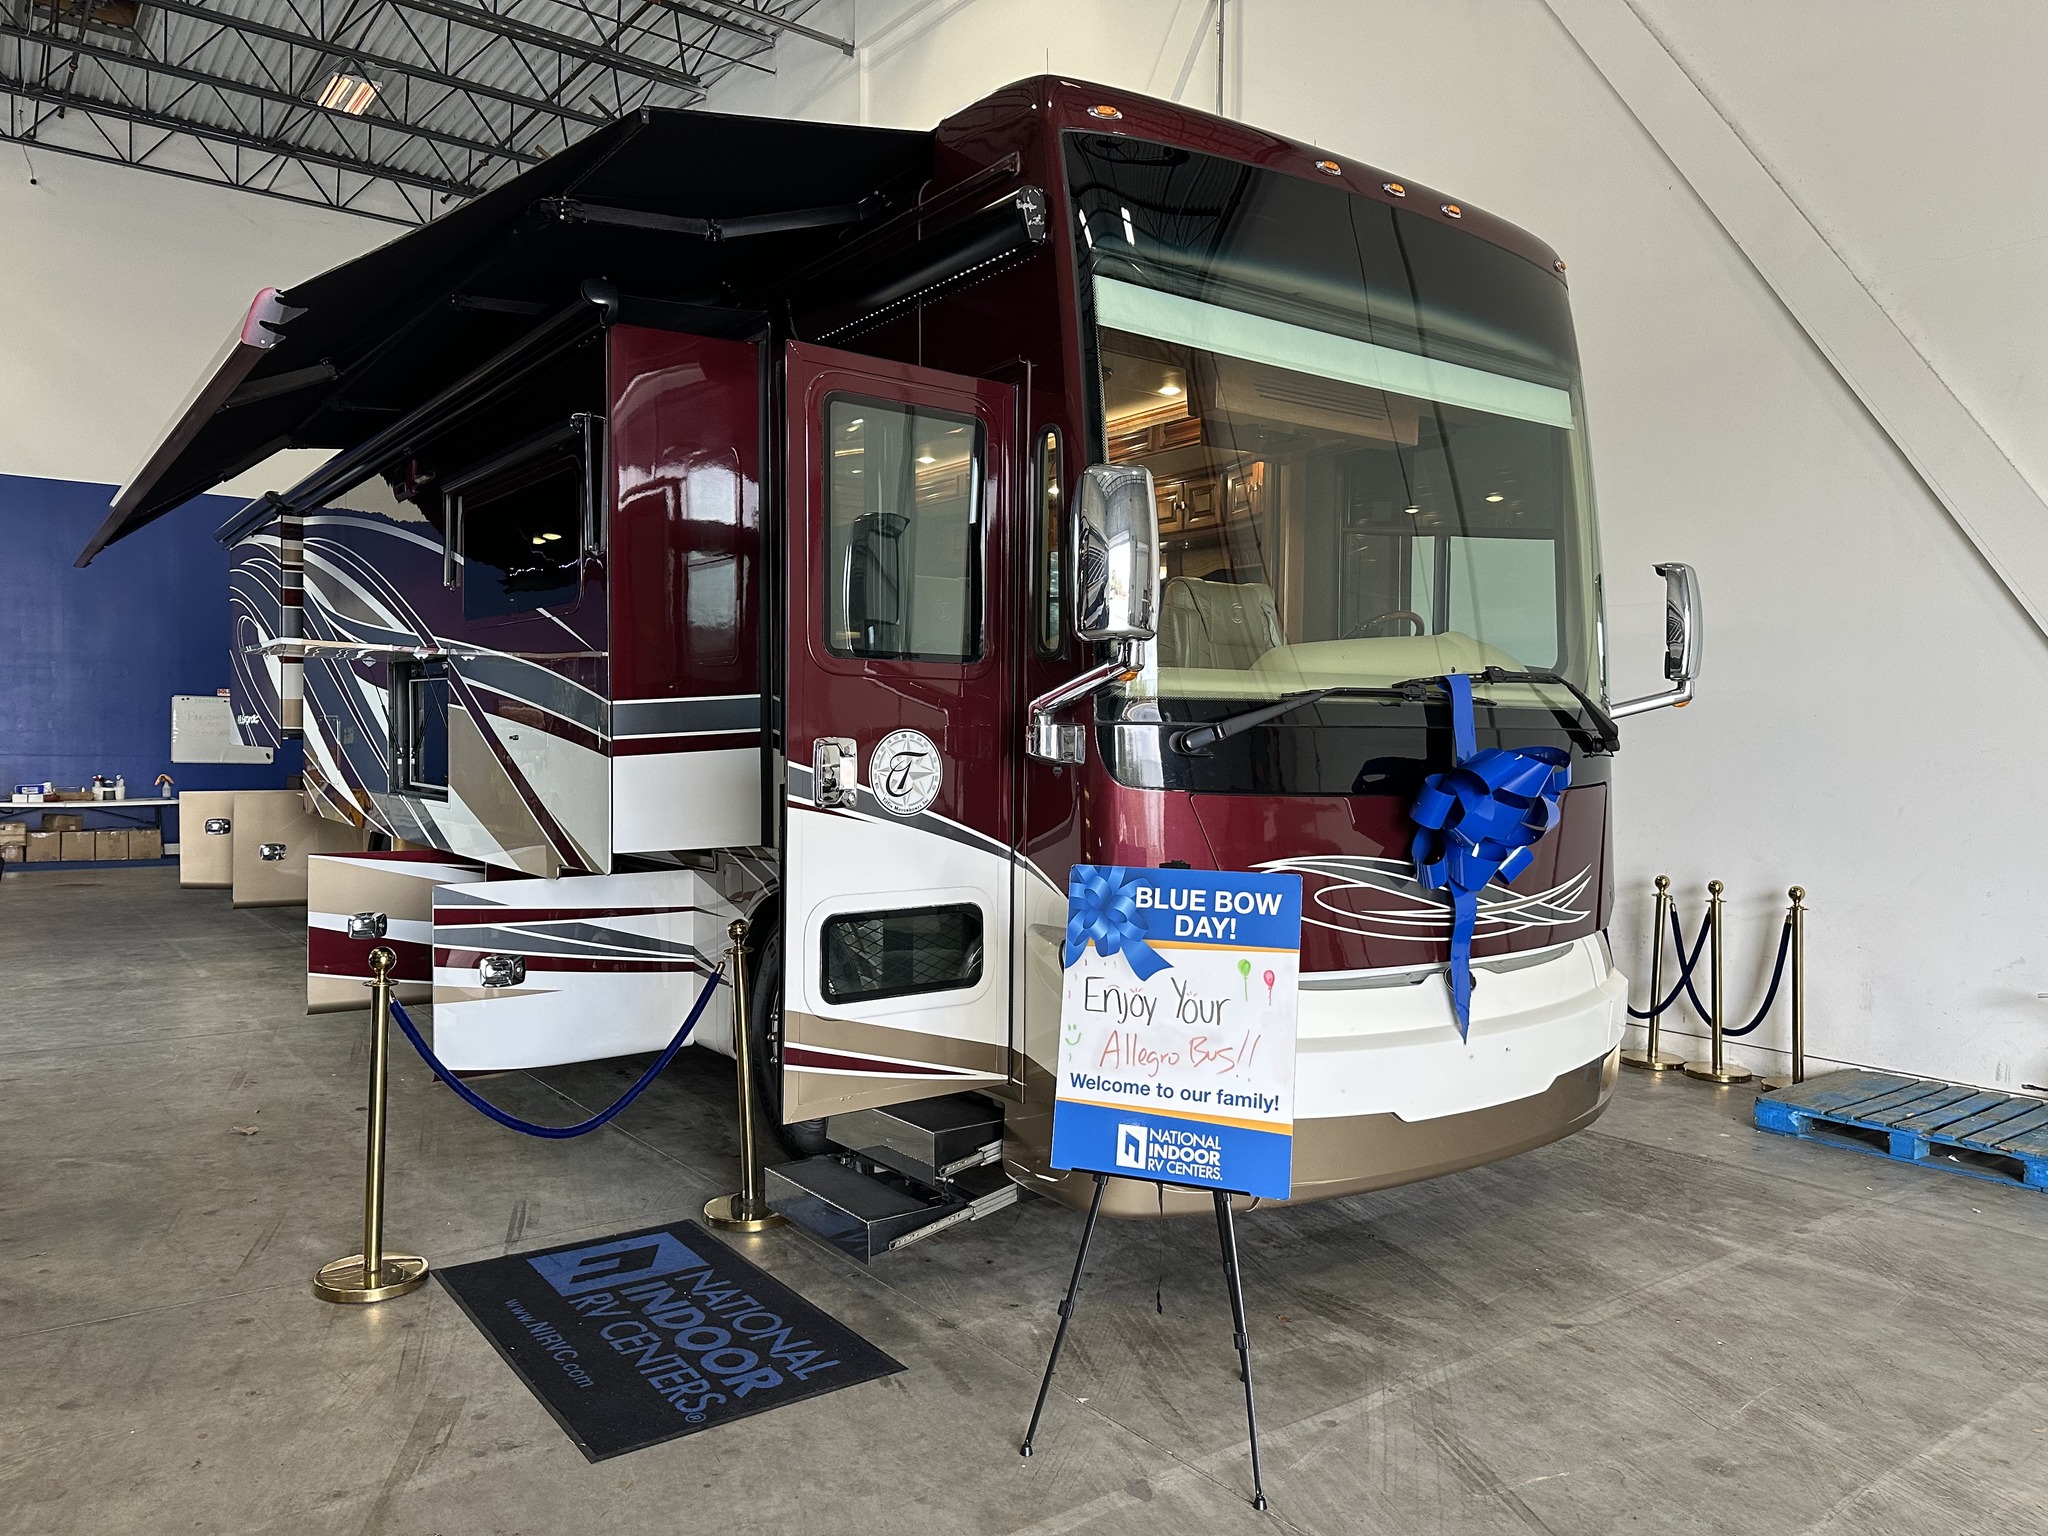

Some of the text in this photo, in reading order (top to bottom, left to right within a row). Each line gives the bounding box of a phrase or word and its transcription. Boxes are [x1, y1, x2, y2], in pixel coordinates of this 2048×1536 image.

[1135, 886, 1283, 916] BLUE BOW
[1174, 914, 1237, 940] DAY!
[1084, 976, 1232, 1026] Enjoy Your
[1099, 1029, 1262, 1083] Allegro Bus!!
[1069, 1072, 1280, 1115] Welcome to our family!
[1148, 1142, 1221, 1167] INDOOR
[1149, 1127, 1222, 1151] NATIONAL
[1147, 1157, 1165, 1173] RV
[567, 1292, 632, 1318] RV
[504, 1298, 595, 1389] www.NIRVC.com
[619, 1280, 784, 1399] INDOOR
[674, 1269, 842, 1382] NATIONAL
